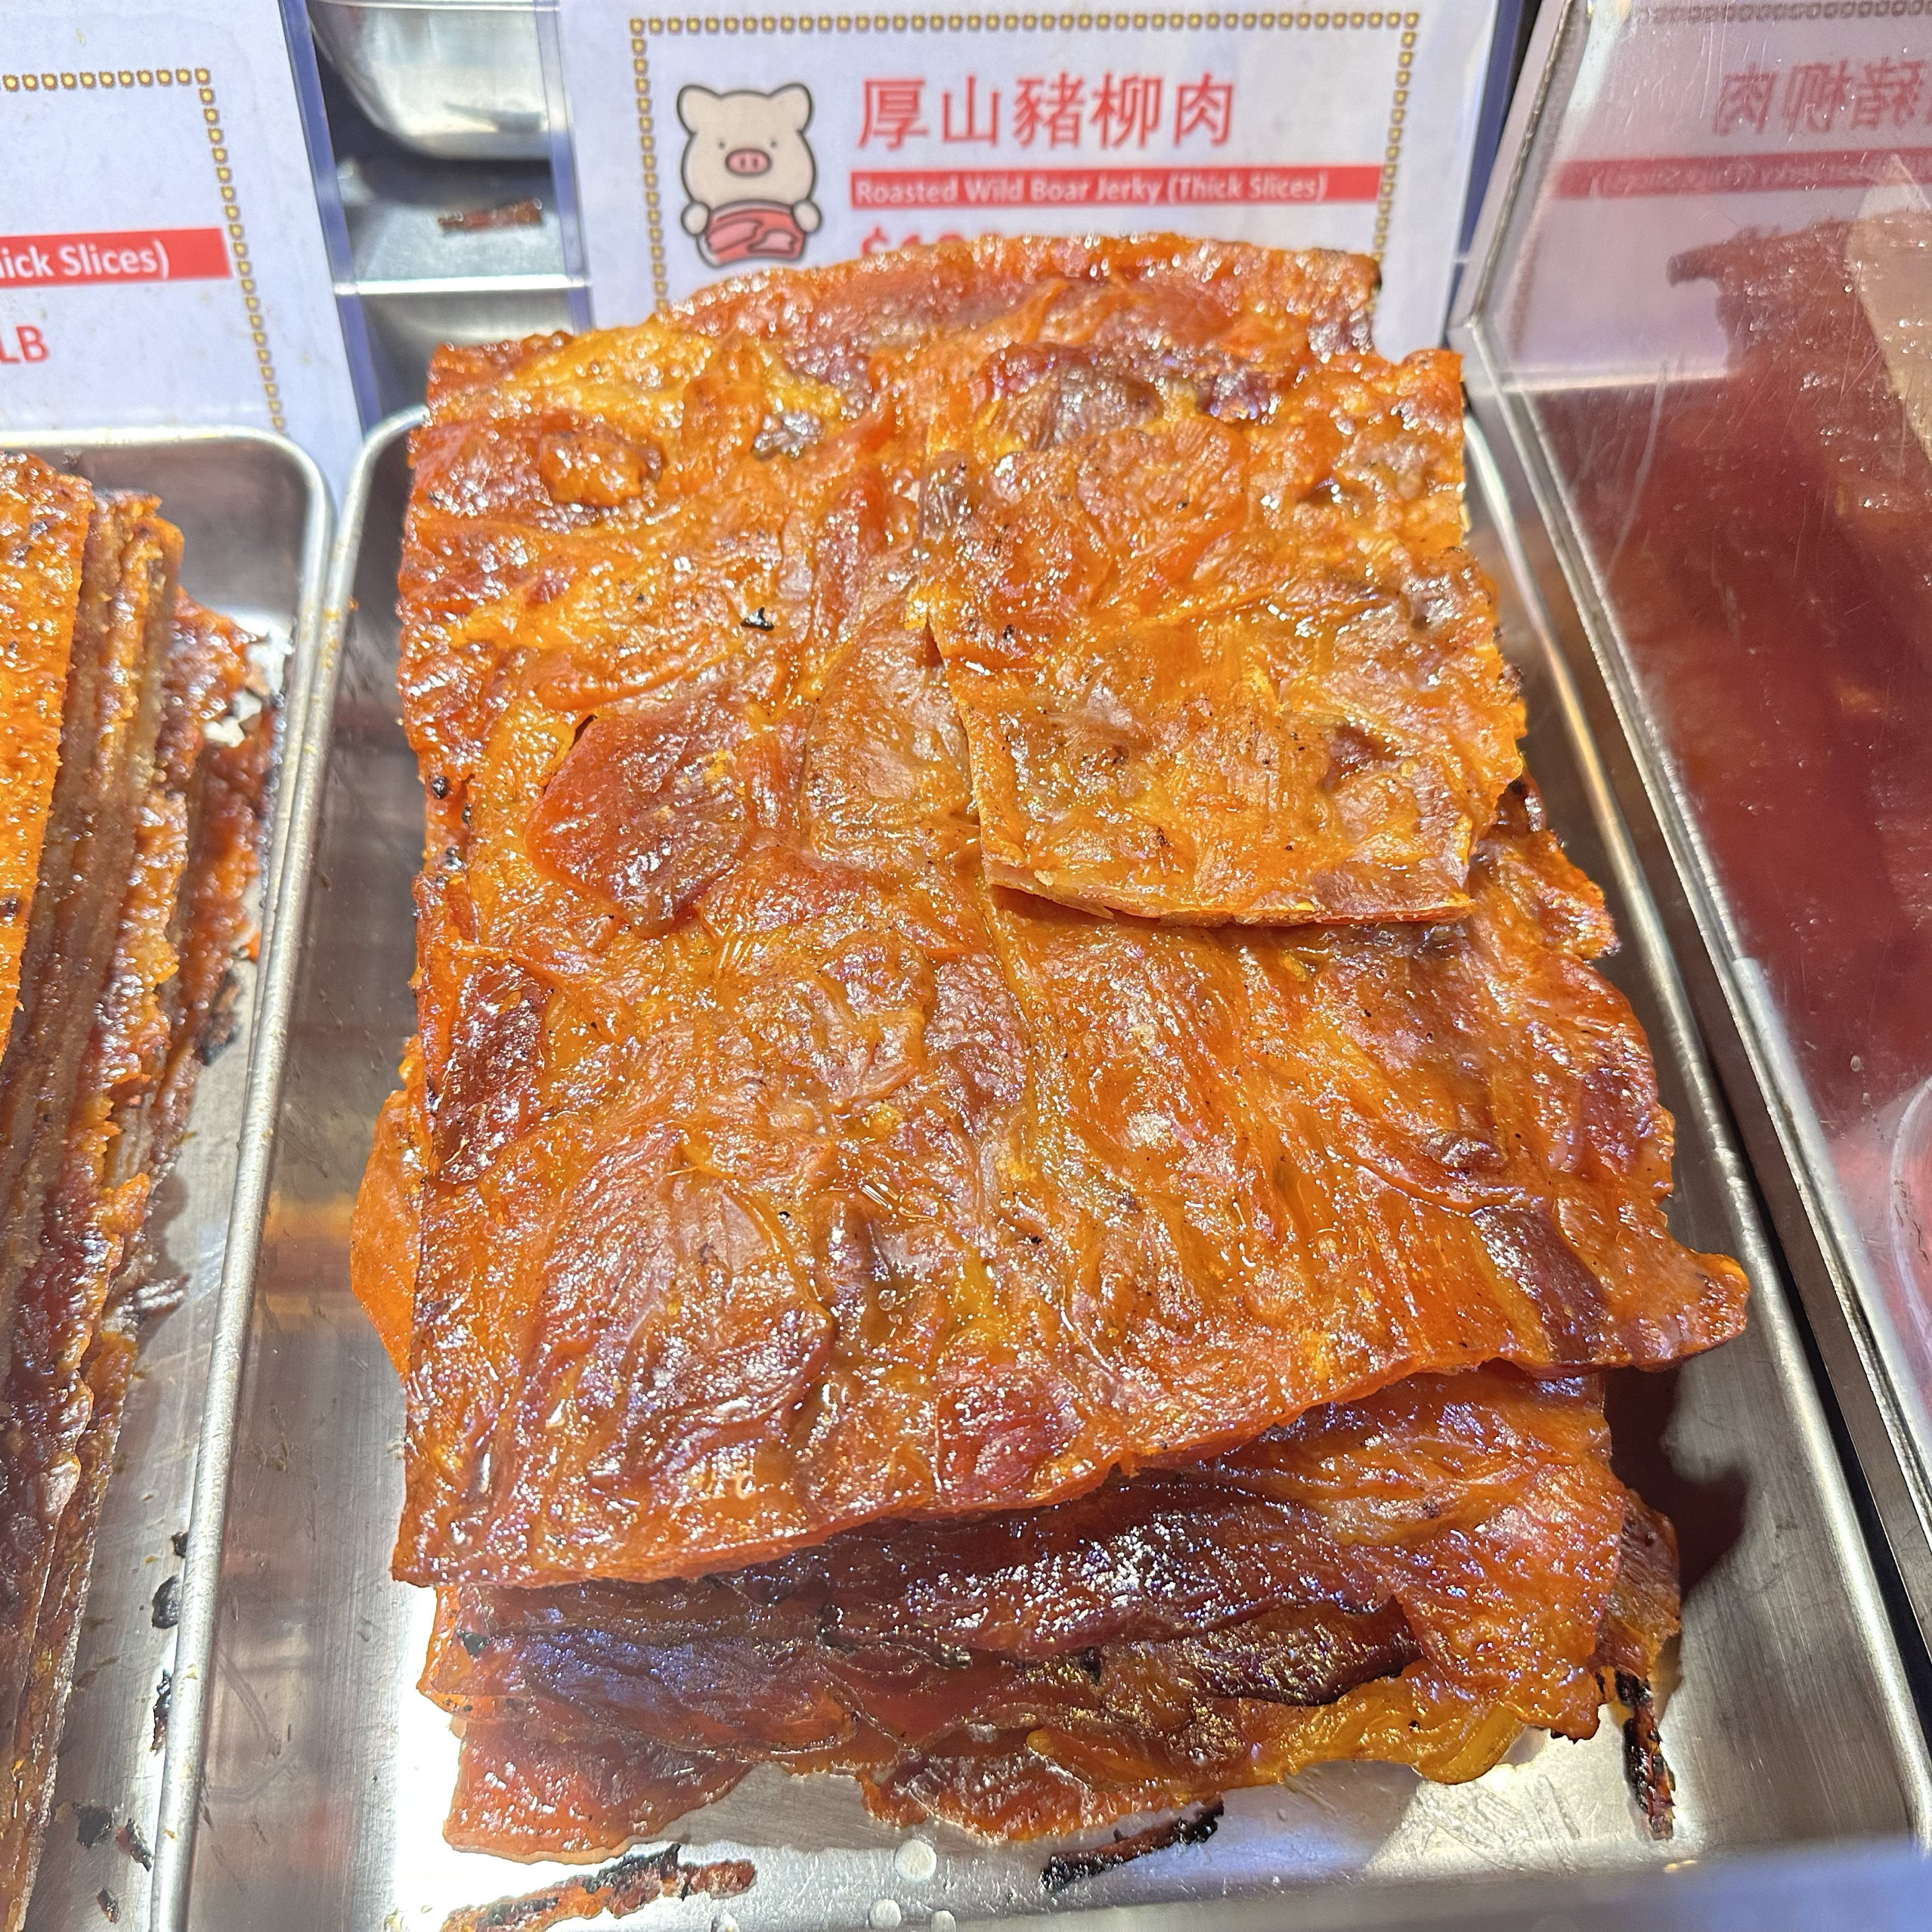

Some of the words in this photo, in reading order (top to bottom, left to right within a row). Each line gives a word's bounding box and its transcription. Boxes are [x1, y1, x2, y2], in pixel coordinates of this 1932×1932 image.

[856, 71, 1234, 150] 厚山豬柳肉
[855, 175, 958, 203] Roasted
[963, 174, 1024, 203] Wild
[1029, 177, 1091, 203] Boar
[1095, 172, 1162, 206] Jerky
[1166, 172, 1243, 204] (Thick
[1248, 170, 1328, 203] Slices)
[0, 245, 54, 279] ick
[58, 238, 170, 280] Slices)
